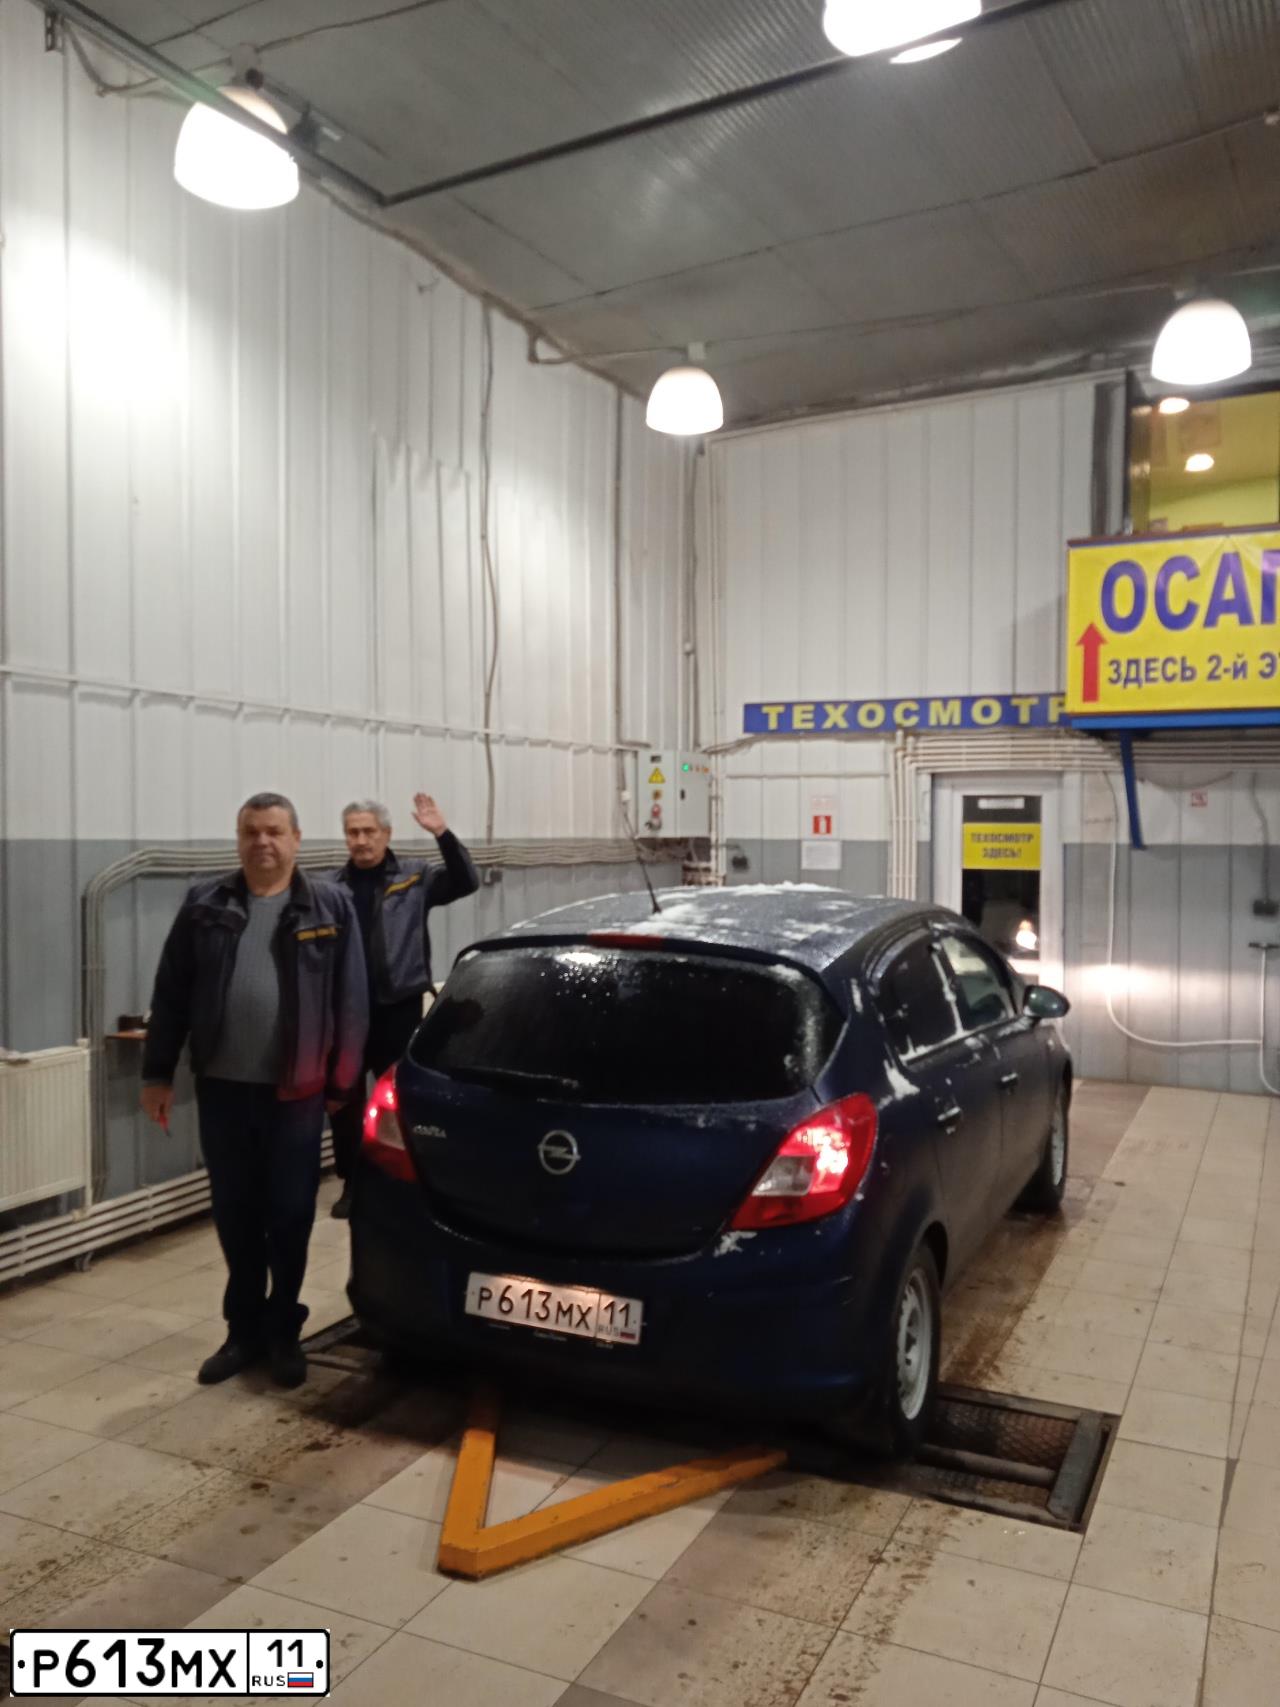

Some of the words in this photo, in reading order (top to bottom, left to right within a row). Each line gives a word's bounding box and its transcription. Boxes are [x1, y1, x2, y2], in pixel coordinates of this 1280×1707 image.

[1108, 656, 1197, 690] ЗДЕСЬ
[1207, 652, 1248, 682] 2-й
[1258, 651, 1280, 680] Э
[603, 1301, 631, 1328] 11
